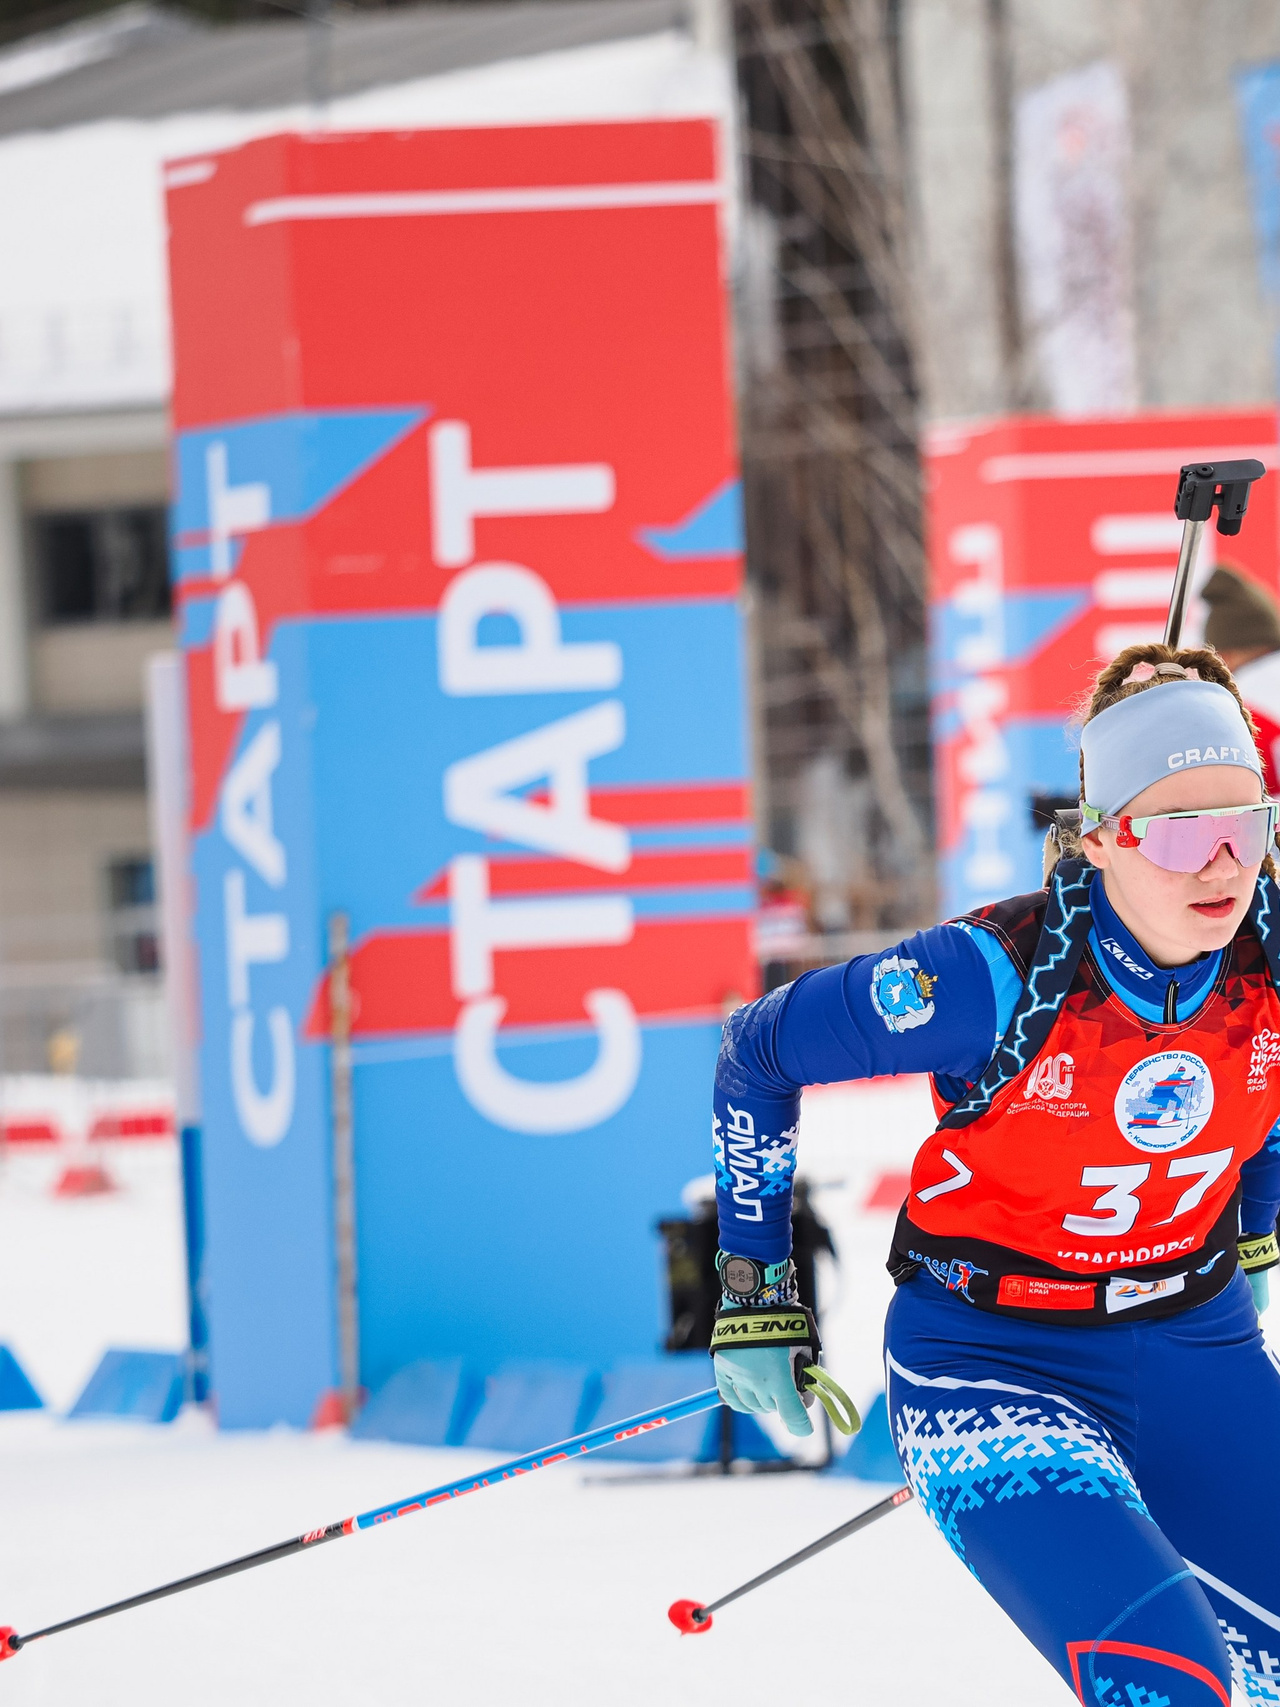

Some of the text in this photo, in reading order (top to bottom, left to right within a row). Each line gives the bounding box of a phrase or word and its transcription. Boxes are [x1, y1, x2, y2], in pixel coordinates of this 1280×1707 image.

[1167, 746, 1240, 769] CRAFT
[428, 419, 643, 1136] СТАРТ
[207, 441, 297, 1148] СТАРТ
[1125, 1053, 1206, 1085] ПЕРВЕНСТВО РОССИИ
[1006, 1104, 1090, 1118] ОССИЙСКОЙ ФЕДЕРАЦИИ
[1060, 1102, 1087, 1110] СПОРТА
[1133, 1134, 1177, 1149] Красноярск
[727, 1102, 763, 1222] ЯМАЛ
[1061, 1146, 1234, 1237] 37
